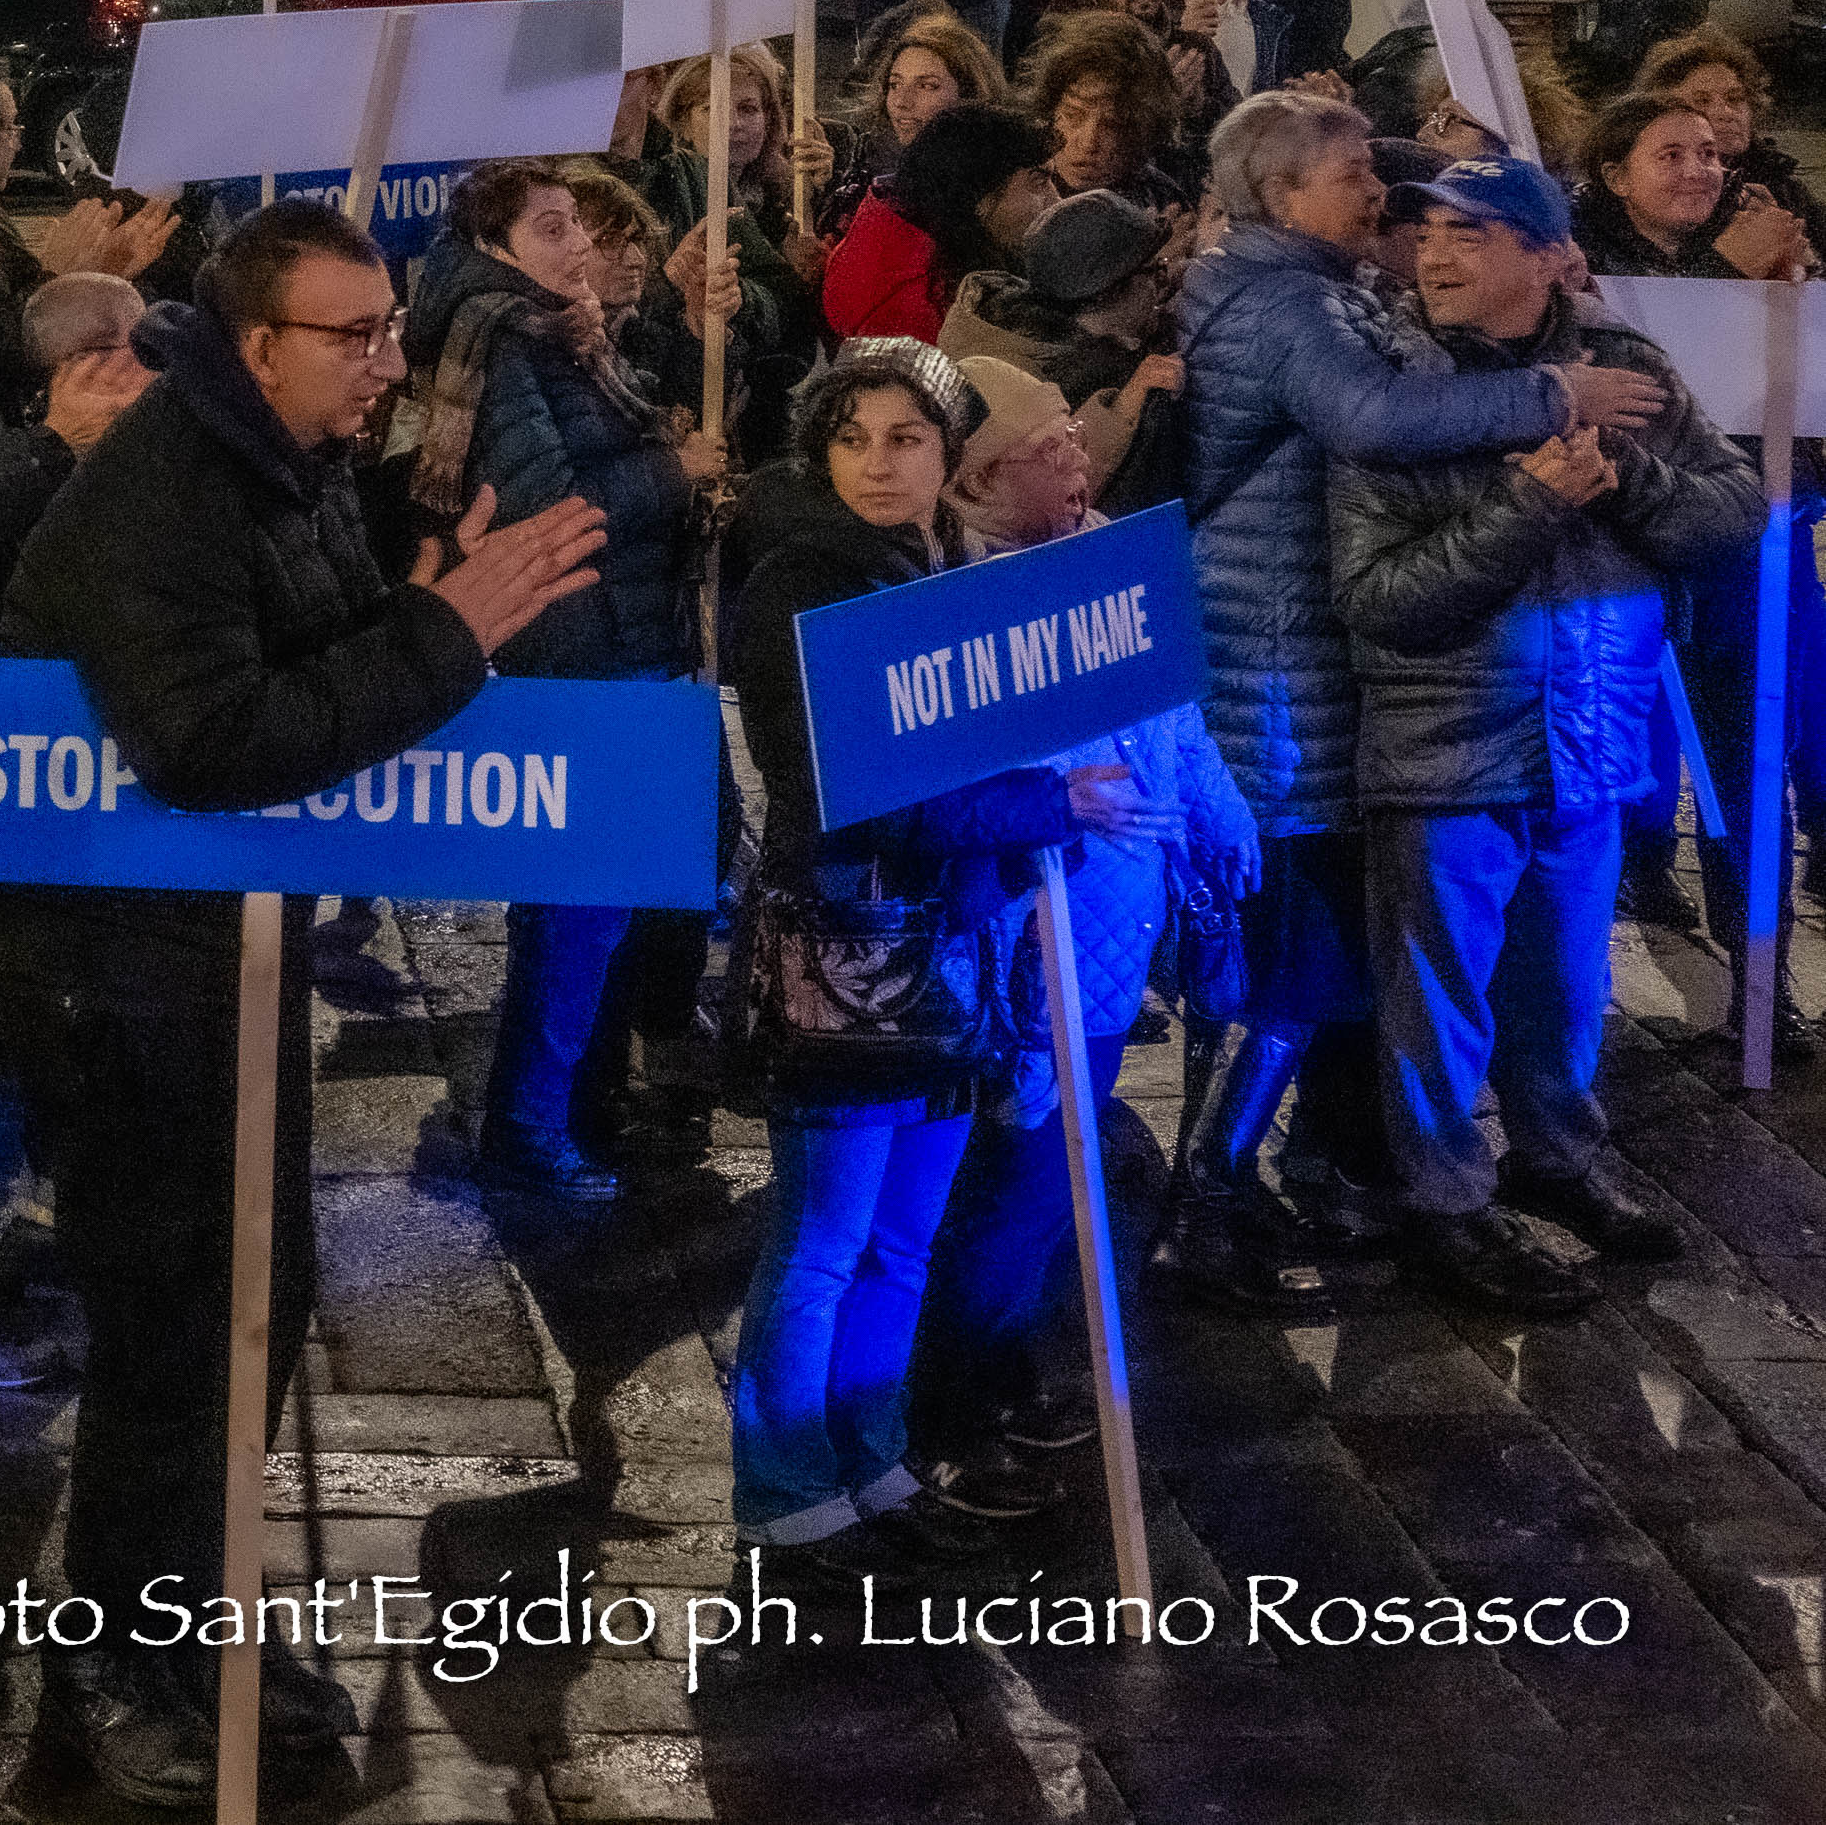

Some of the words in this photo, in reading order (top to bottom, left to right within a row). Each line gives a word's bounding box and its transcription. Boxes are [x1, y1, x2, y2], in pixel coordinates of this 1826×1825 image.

[886, 647, 954, 735] NOT
[961, 633, 1001, 710] IN
[1007, 613, 1061, 686] MY
[1067, 584, 1153, 675] NAME
